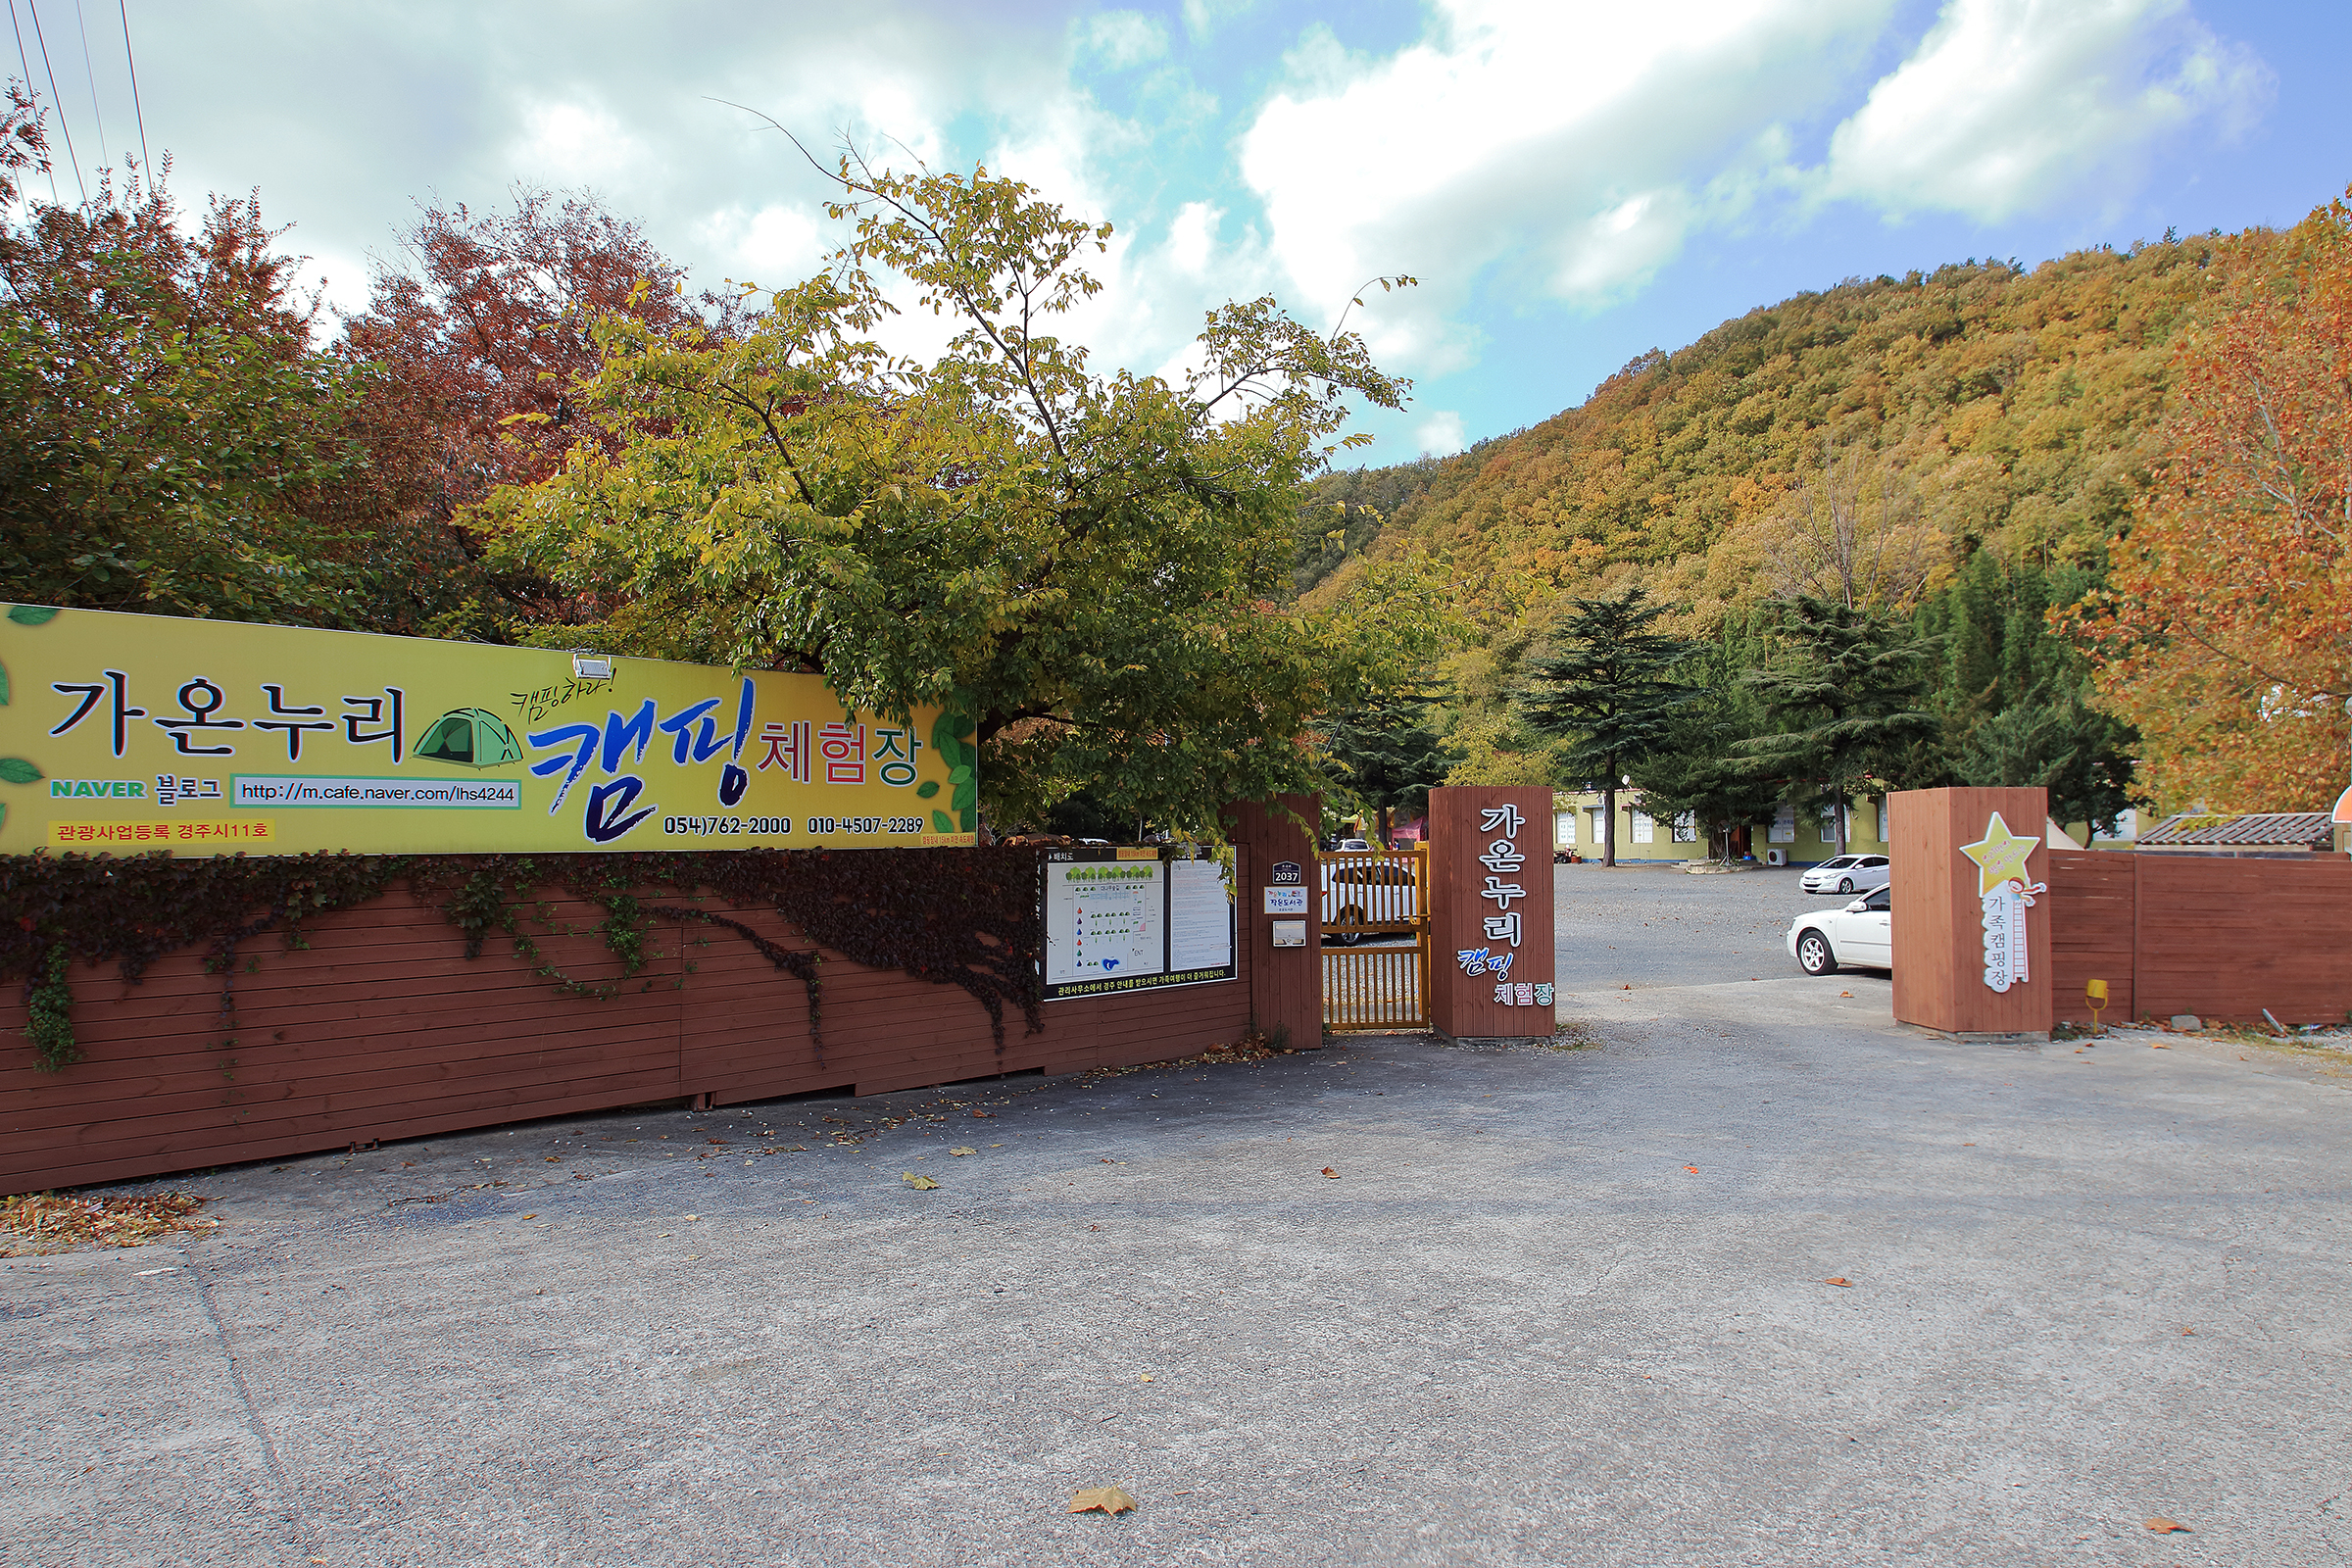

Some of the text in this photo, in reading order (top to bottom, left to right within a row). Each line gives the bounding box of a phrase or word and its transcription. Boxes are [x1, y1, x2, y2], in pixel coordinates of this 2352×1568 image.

[510, 667, 616, 725] 캠핑하라!
[50, 668, 922, 844] 가온누리 캠핑 체험장
[51, 773, 514, 806] NAVER 블로그 http://m.cafe.naver.com/lhs4244
[57, 822, 269, 841] 관광사업등록 경주시11호
[663, 816, 924, 837] 054)762-2000 010-4507-2289
[1054, 852, 1074, 861] 배치도
[2003, 845, 2027, 862] 만드는
[1275, 872, 1298, 882] 2037
[1479, 804, 1526, 947] 가온누리
[1270, 898, 1303, 906] 작은도서관
[1988, 896, 2007, 986] 가족캠핑장
[1457, 946, 1514, 982] 캠핑
[1102, 981, 1115, 991] 경주
[1494, 982, 1554, 1006] 체험장
